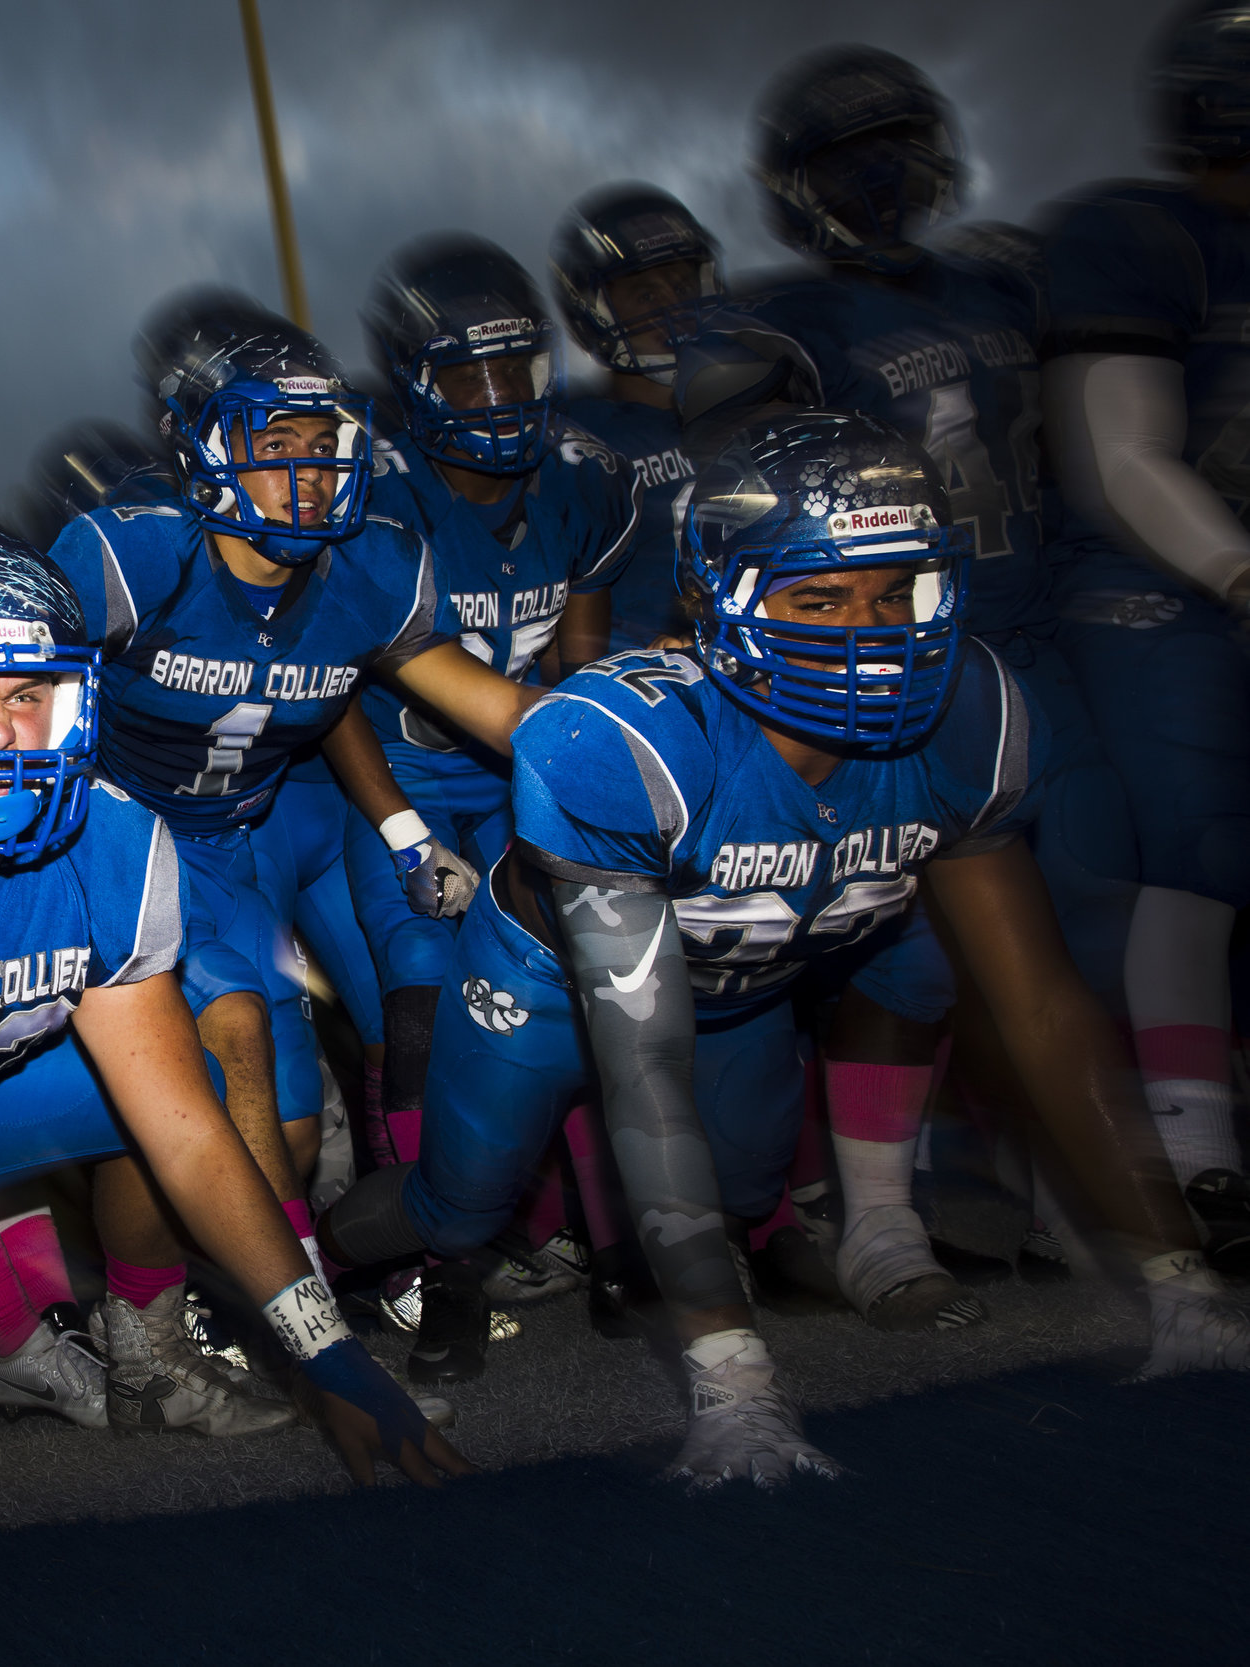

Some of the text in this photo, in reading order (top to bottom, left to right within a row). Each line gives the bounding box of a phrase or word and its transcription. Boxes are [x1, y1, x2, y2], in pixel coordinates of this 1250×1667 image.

[480, 320, 518, 335] Riddell
[878, 341, 972, 399] BARRON
[287, 379, 326, 391] Riddell
[851, 508, 909, 530] Riddell
[501, 561, 517, 576] BC
[256, 631, 275, 649] BC
[150, 649, 359, 701] BARRON COLLIER
[173, 701, 274, 796] 1
[816, 802, 838, 824] BC
[710, 821, 941, 891] ARRON COLLIER
